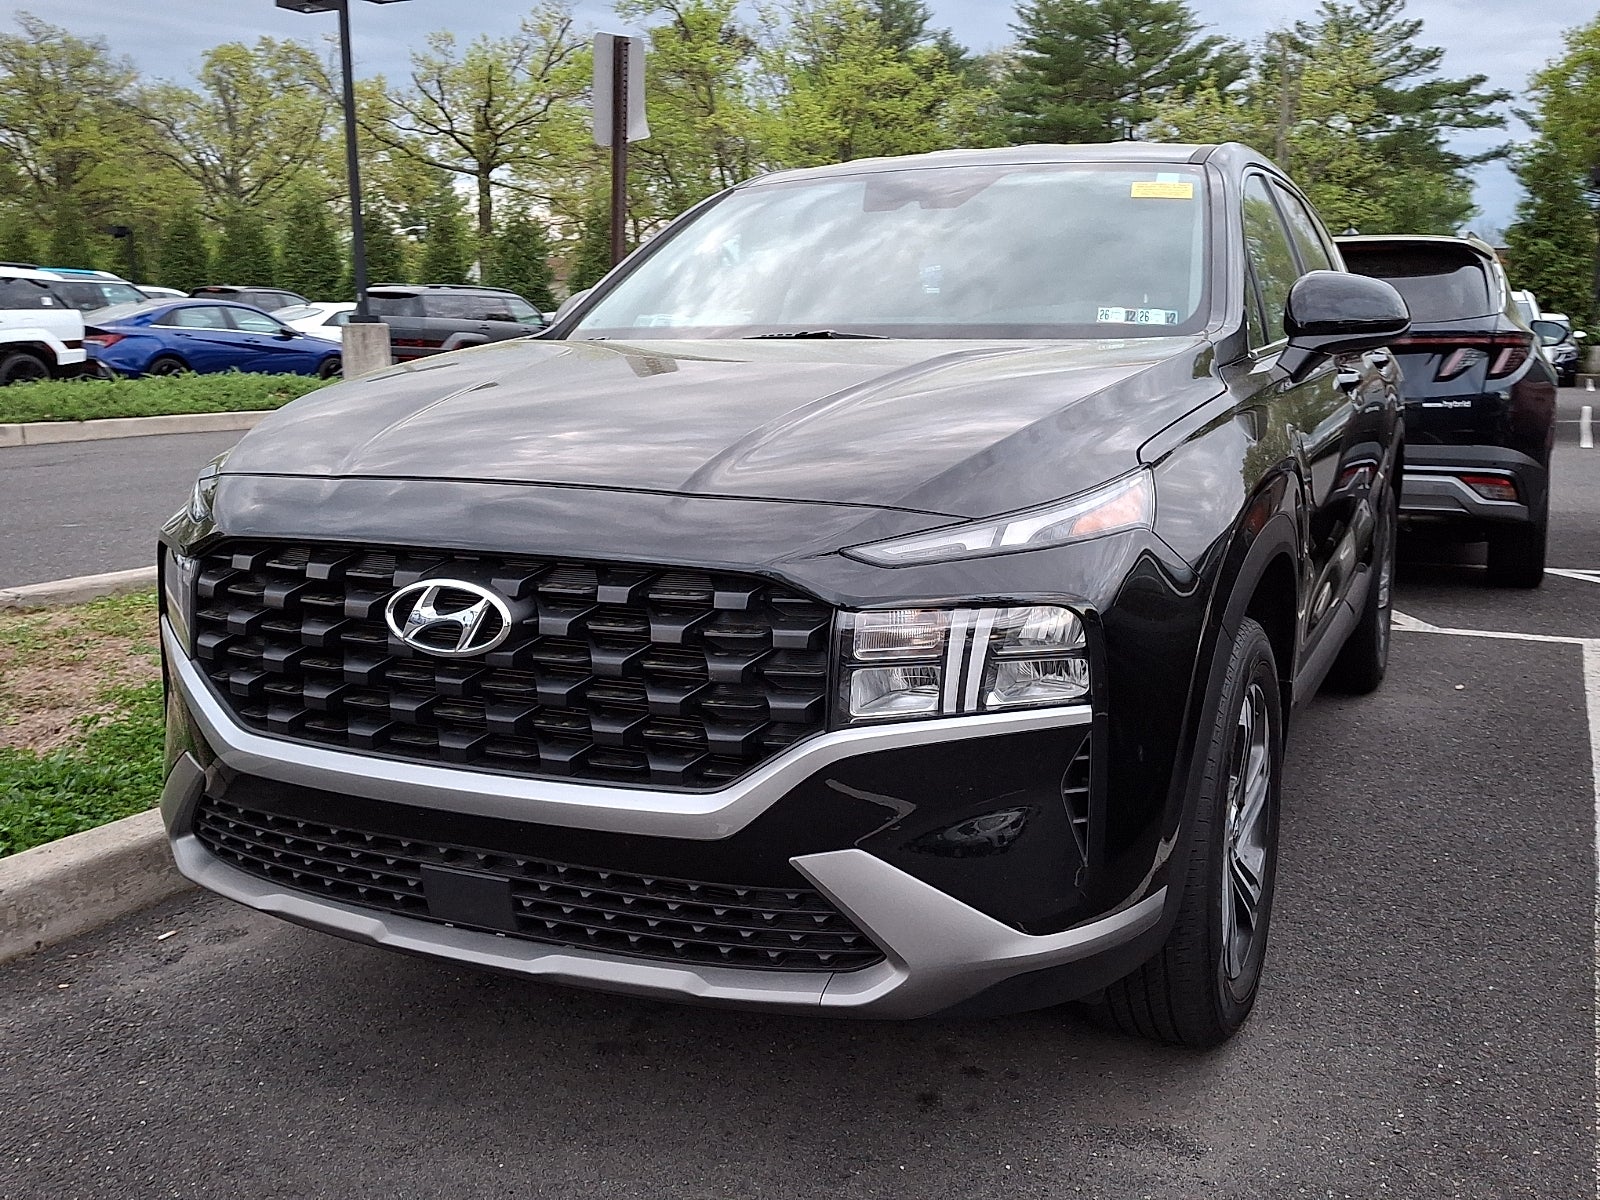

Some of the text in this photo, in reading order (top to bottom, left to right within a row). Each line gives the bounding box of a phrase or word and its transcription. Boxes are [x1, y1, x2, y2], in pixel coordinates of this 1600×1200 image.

[1099, 309, 1136, 322] 26 12
[1139, 310, 1150, 322] 26
